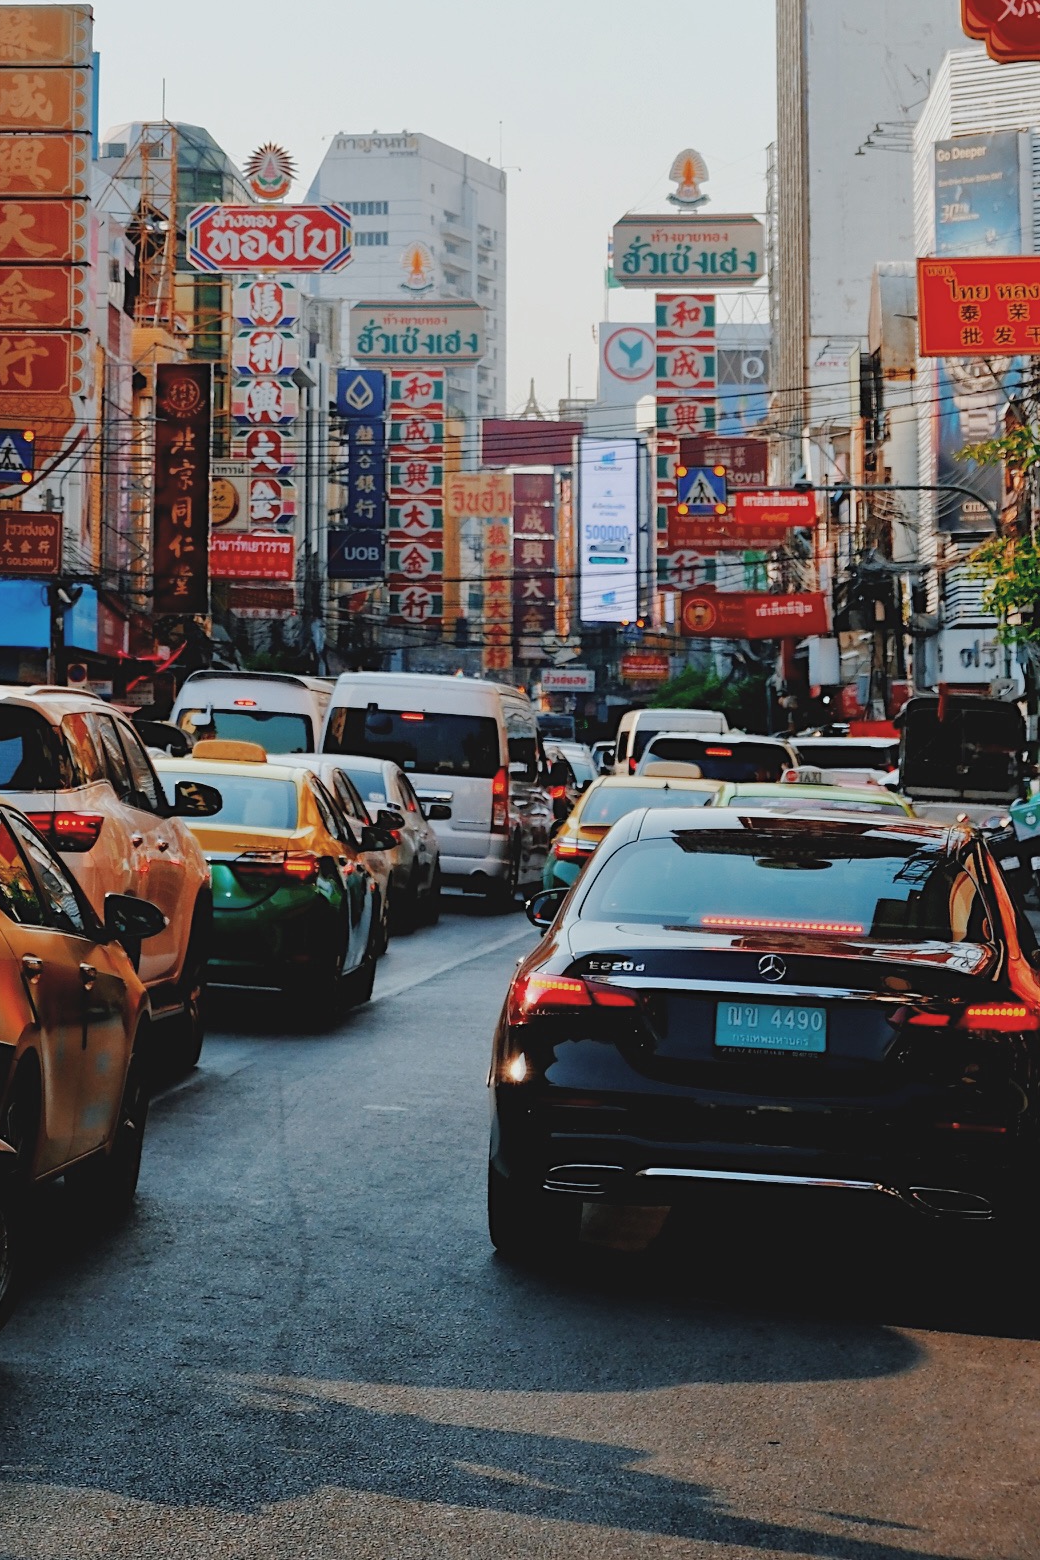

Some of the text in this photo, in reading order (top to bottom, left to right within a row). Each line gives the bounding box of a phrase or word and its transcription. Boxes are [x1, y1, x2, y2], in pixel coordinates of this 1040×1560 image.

[936, 149, 951, 162] Go
[206, 214, 338, 262] ทองใบ
[727, 470, 765, 486] Royal
[344, 546, 380, 561] UOB
[799, 771, 822, 783] TAXI
[770, 1010, 823, 1032] 4490
